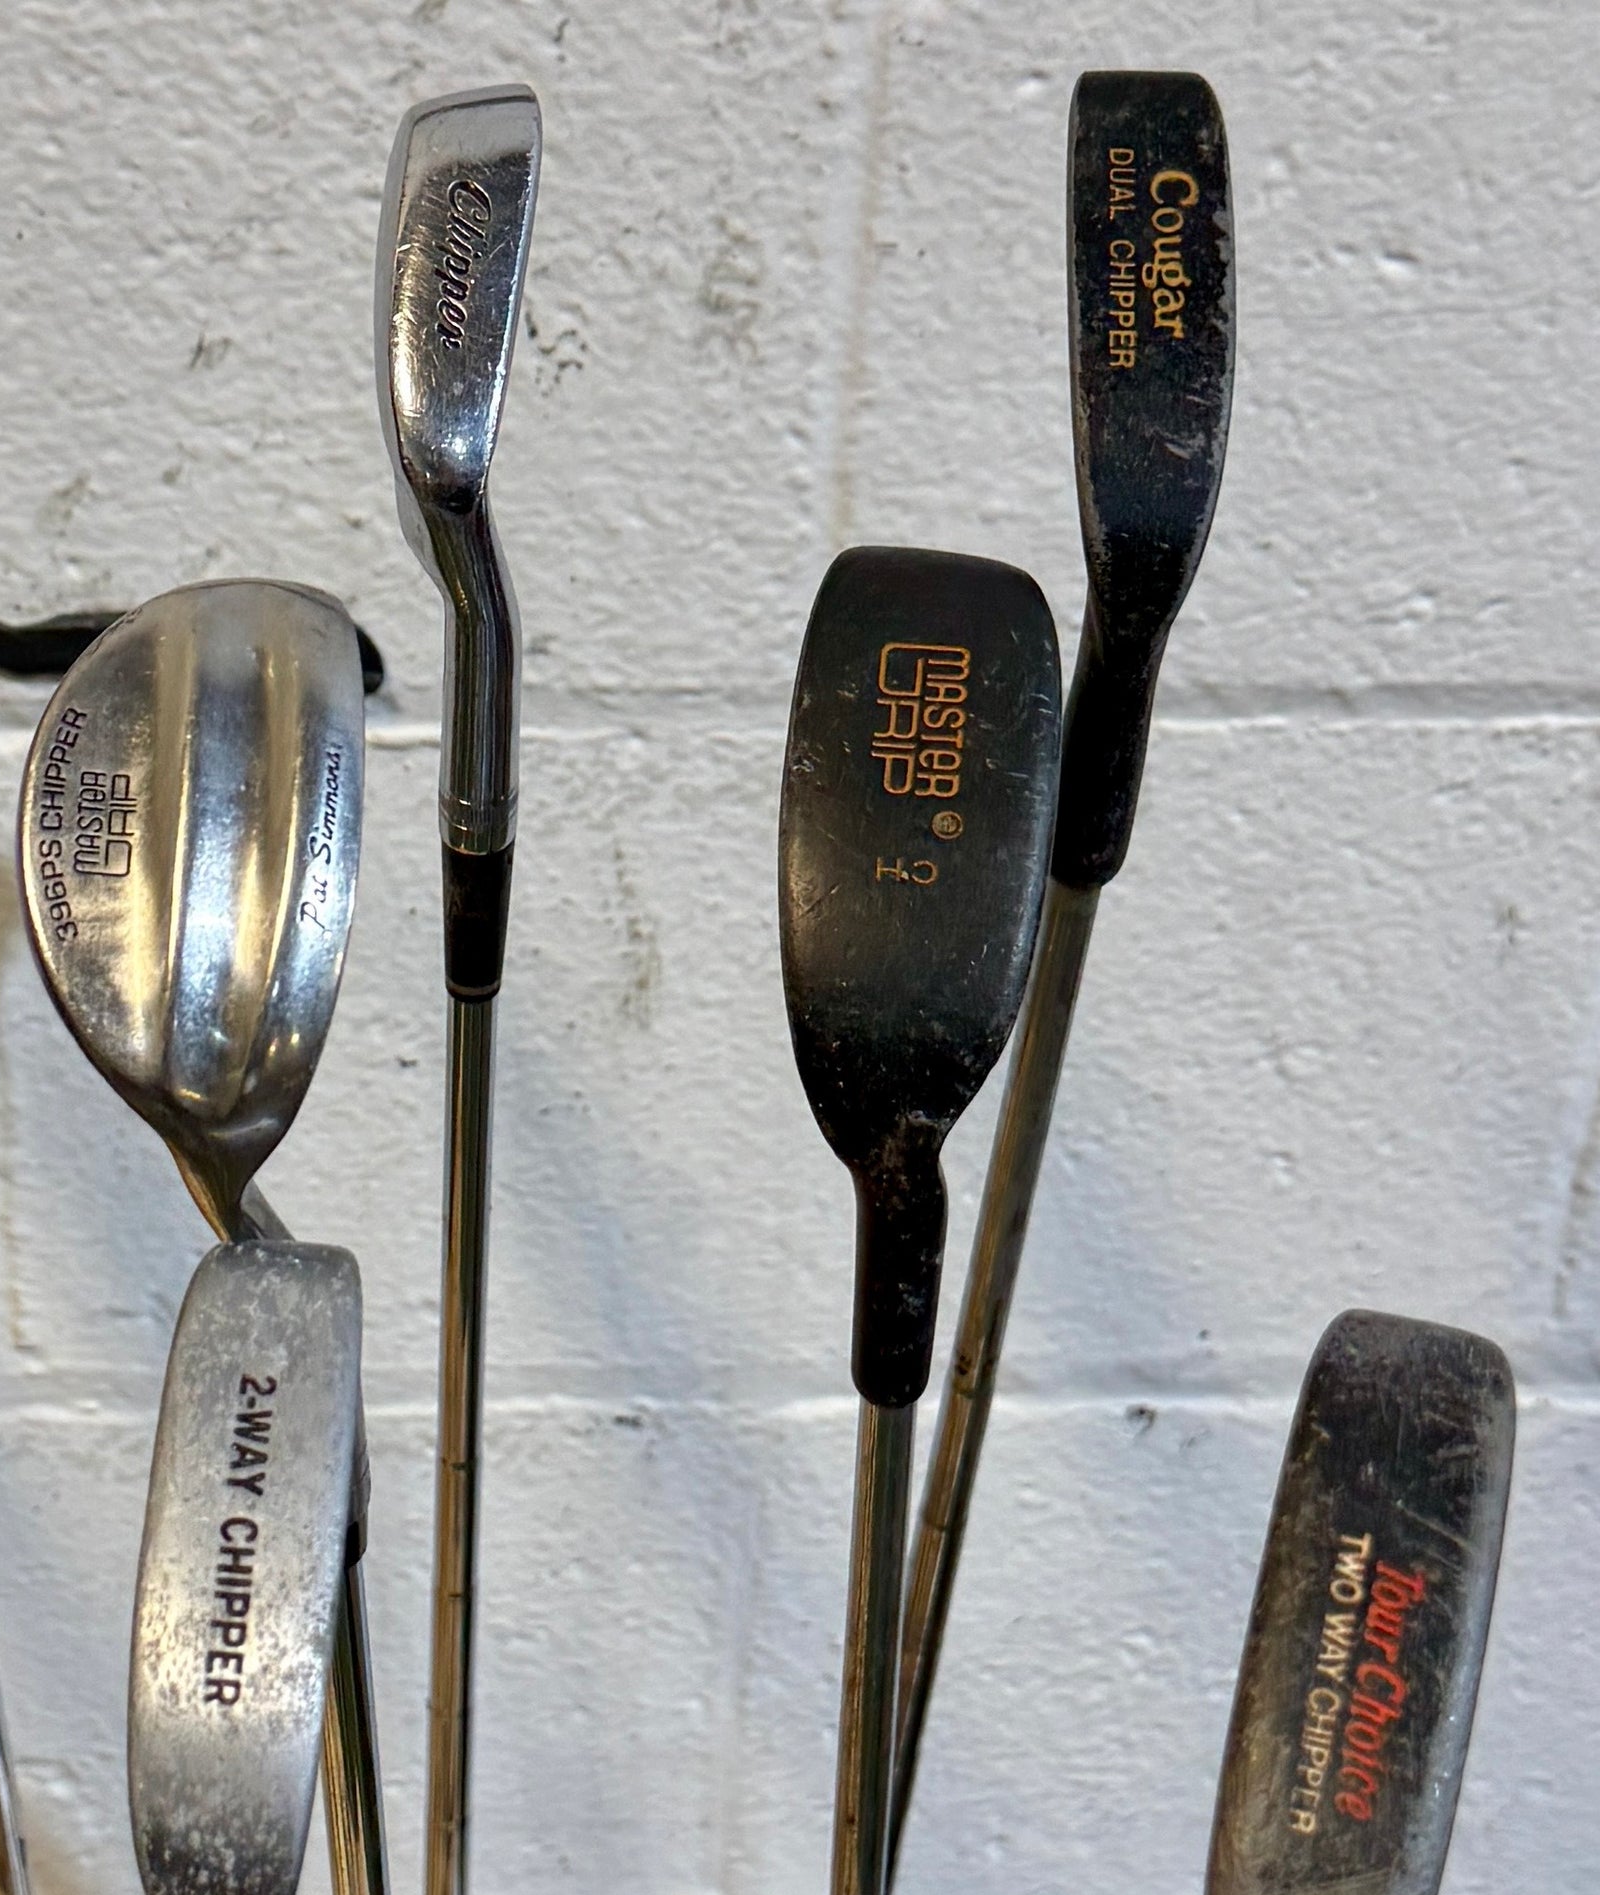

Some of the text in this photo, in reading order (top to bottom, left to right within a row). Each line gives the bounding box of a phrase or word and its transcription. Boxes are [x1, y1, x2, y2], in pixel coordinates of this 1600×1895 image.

[434, 179, 492, 350] Chipper
[1108, 148, 1138, 369] DUAL CHIPPER
[1141, 169, 1199, 339] Cougar
[38, 707, 88, 943] 396PS CHIPPER
[104, 774, 137, 877] GRIP
[871, 642, 926, 795] GRIP
[203, 1373, 278, 1706] 2-WAY CHIPPER
[1290, 1531, 1373, 1836] TWO WAY CHIPPER
[1334, 1559, 1425, 1822] Tour Choice
